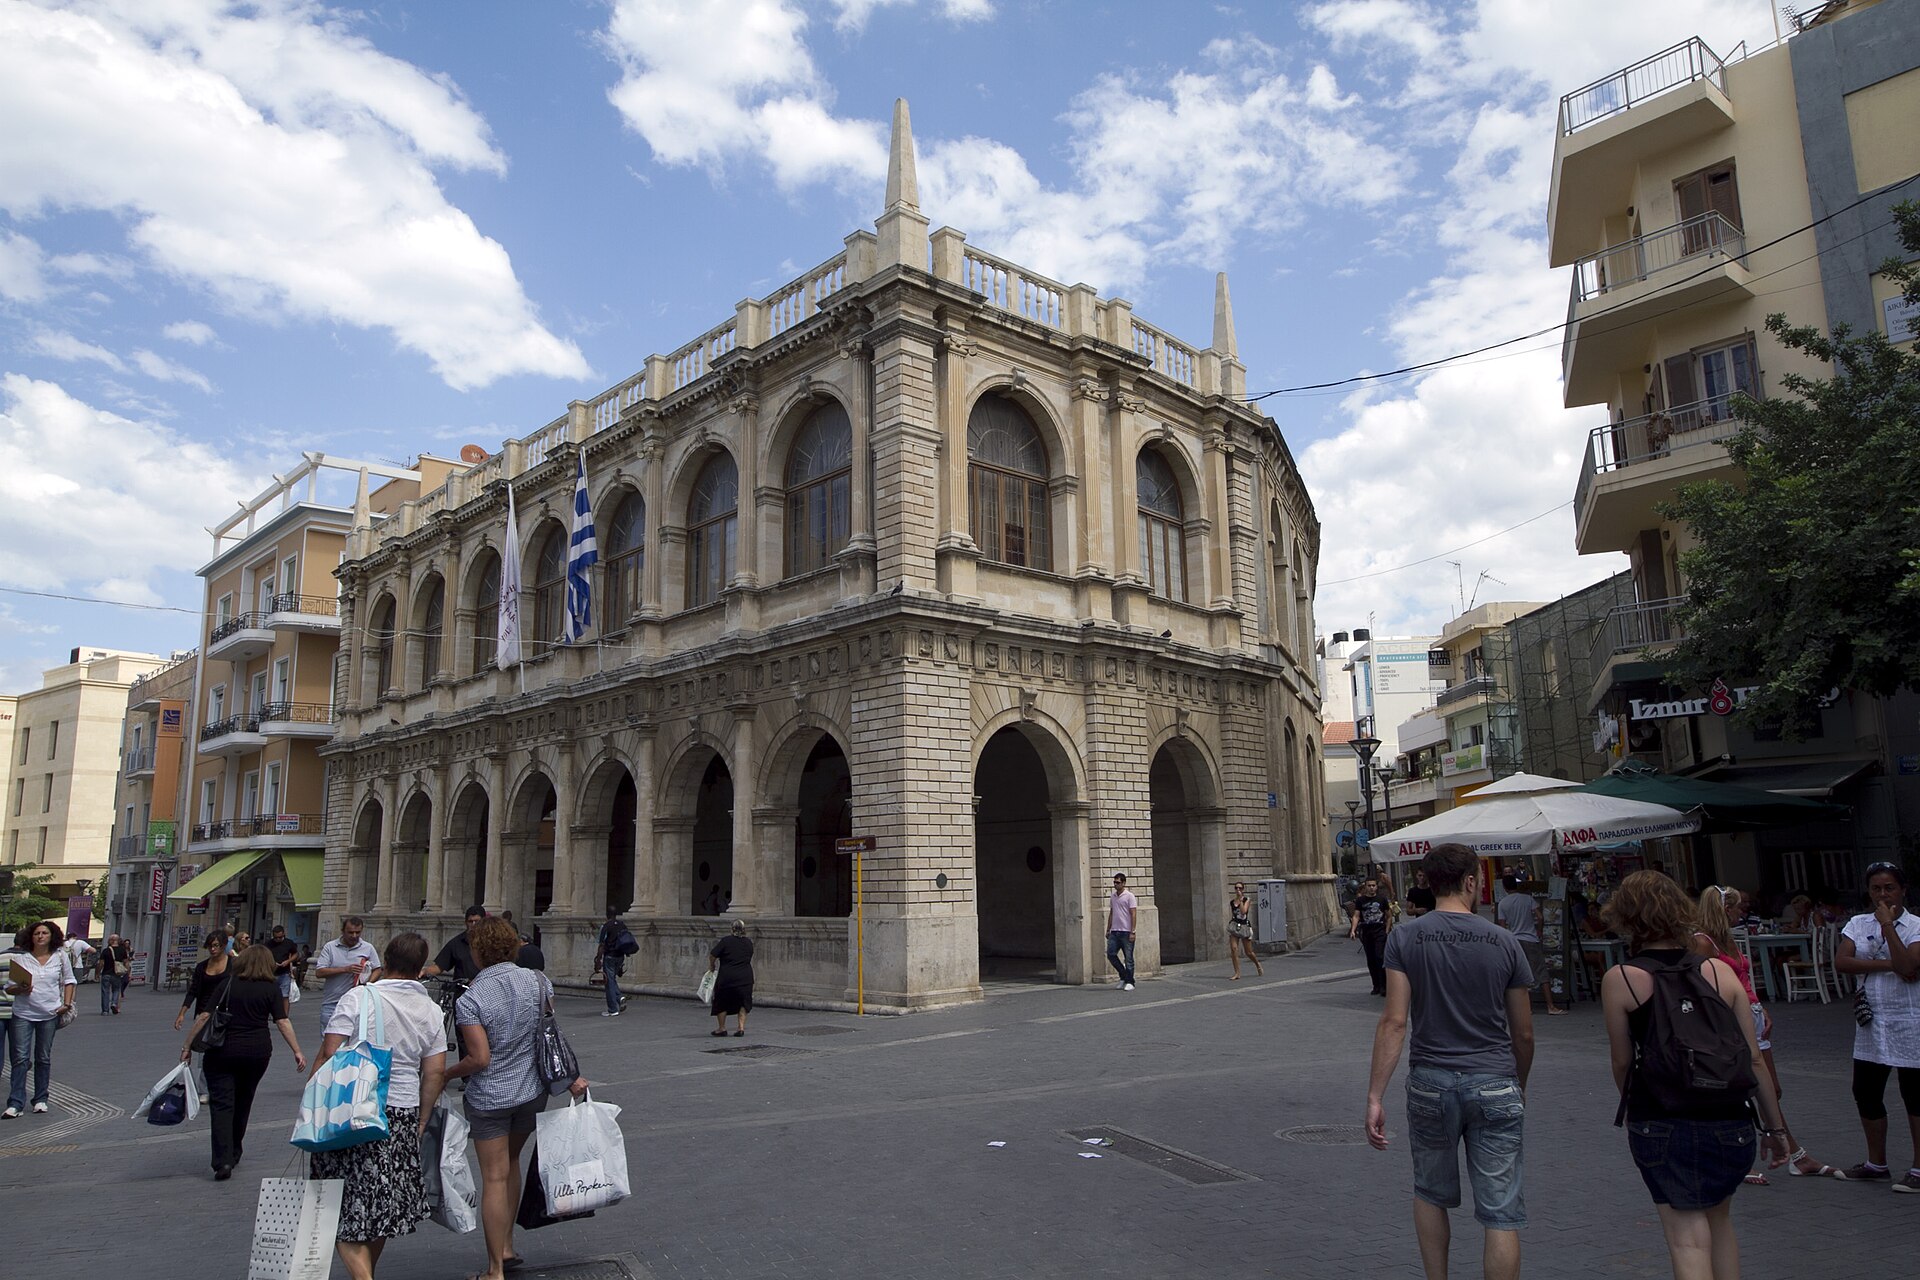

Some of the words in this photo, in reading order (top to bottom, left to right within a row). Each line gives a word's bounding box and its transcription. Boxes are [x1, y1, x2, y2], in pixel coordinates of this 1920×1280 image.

[1563, 827, 1597, 846] ΑΛΦΑ
[1599, 827, 1644, 840] ΠΑΡΑΔΟΣΙΑΚΗ
[1644, 824, 1676, 834] ΕΛΛΗΝΙΚΗ
[1398, 840, 1432, 856] ALFA
[153, 870, 164, 911] CARAVEL
[554, 1184, 574, 1198] Ulla
[576, 1178, 614, 1196] Popken
